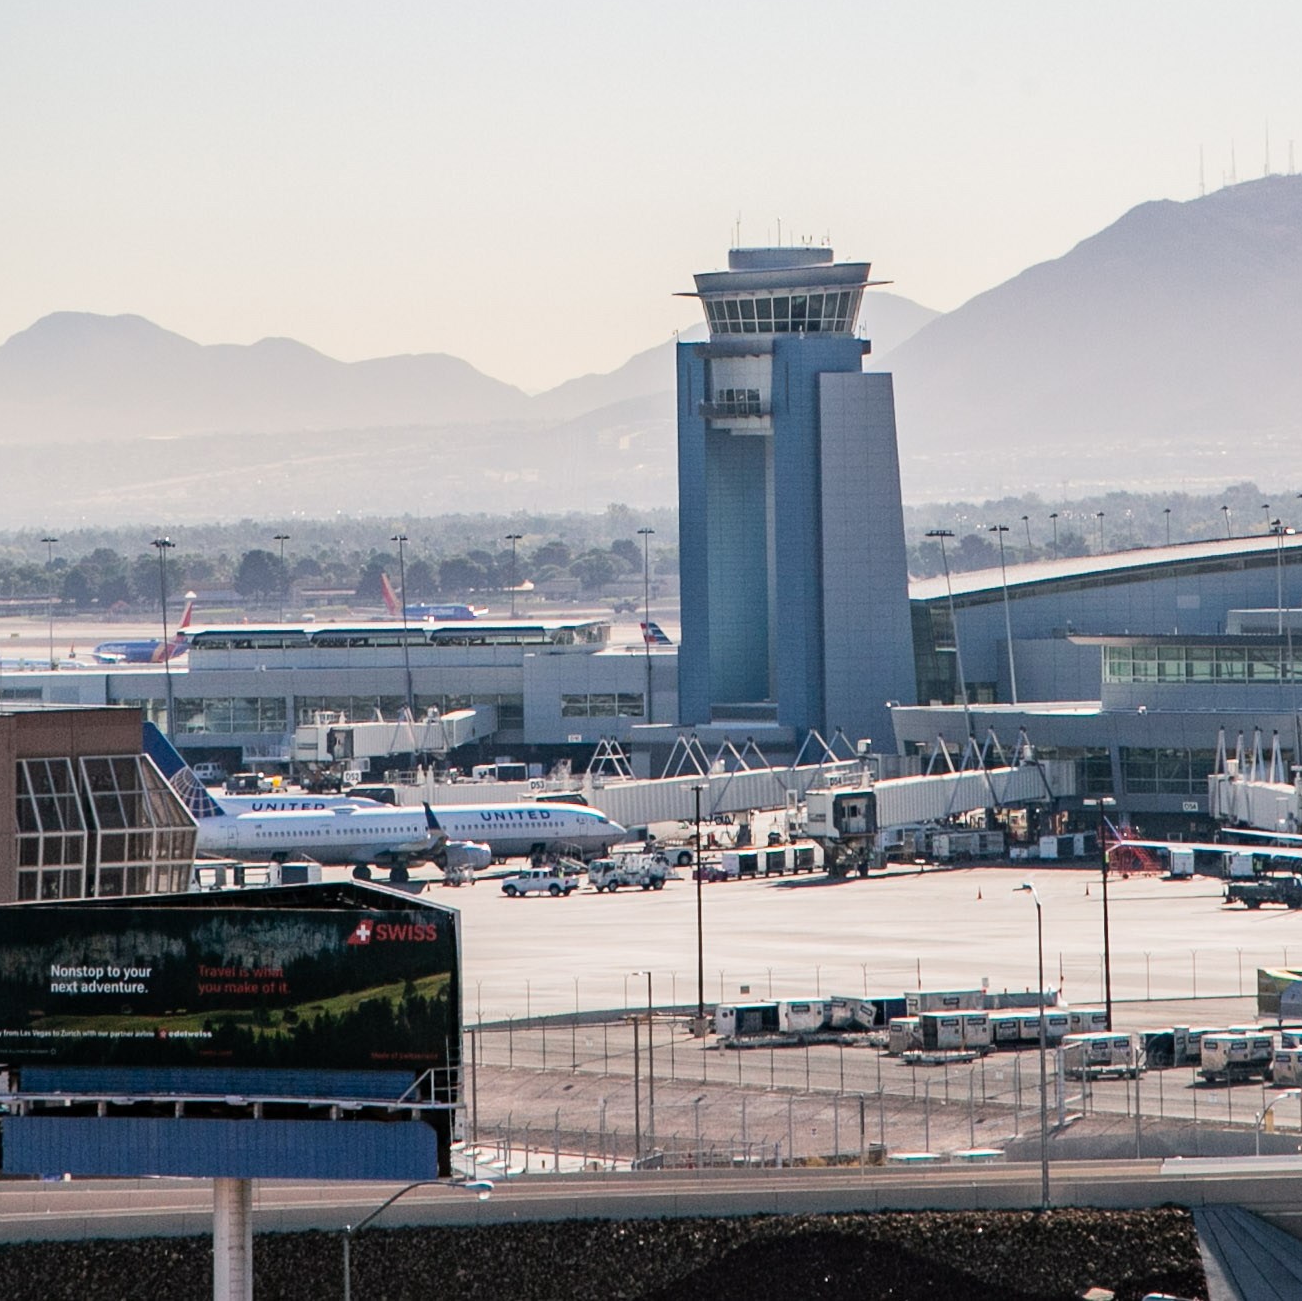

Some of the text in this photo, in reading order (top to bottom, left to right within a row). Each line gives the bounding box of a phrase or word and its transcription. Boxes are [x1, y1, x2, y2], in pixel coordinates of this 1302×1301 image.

[345, 772, 360, 781] D52
[530, 781, 545, 790] D53
[252, 802, 326, 812] UNITED
[480, 810, 551, 822] UNITED
[376, 923, 438, 942] SWISS
[50, 964, 152, 981] Nonstop to your
[198, 964, 284, 978] Travel is what
[50, 980, 149, 993] next adventure.
[198, 981, 292, 996] you make of it.
[4, 1029, 19, 1037] from
[20, 1029, 31, 1037] Las
[32, 1029, 51, 1039] Vegas
[52, 1029, 59, 1037] to
[61, 1029, 82, 1037] Zurich
[82, 1029, 97, 1037] with
[168, 1029, 213, 1038] edelweiss
